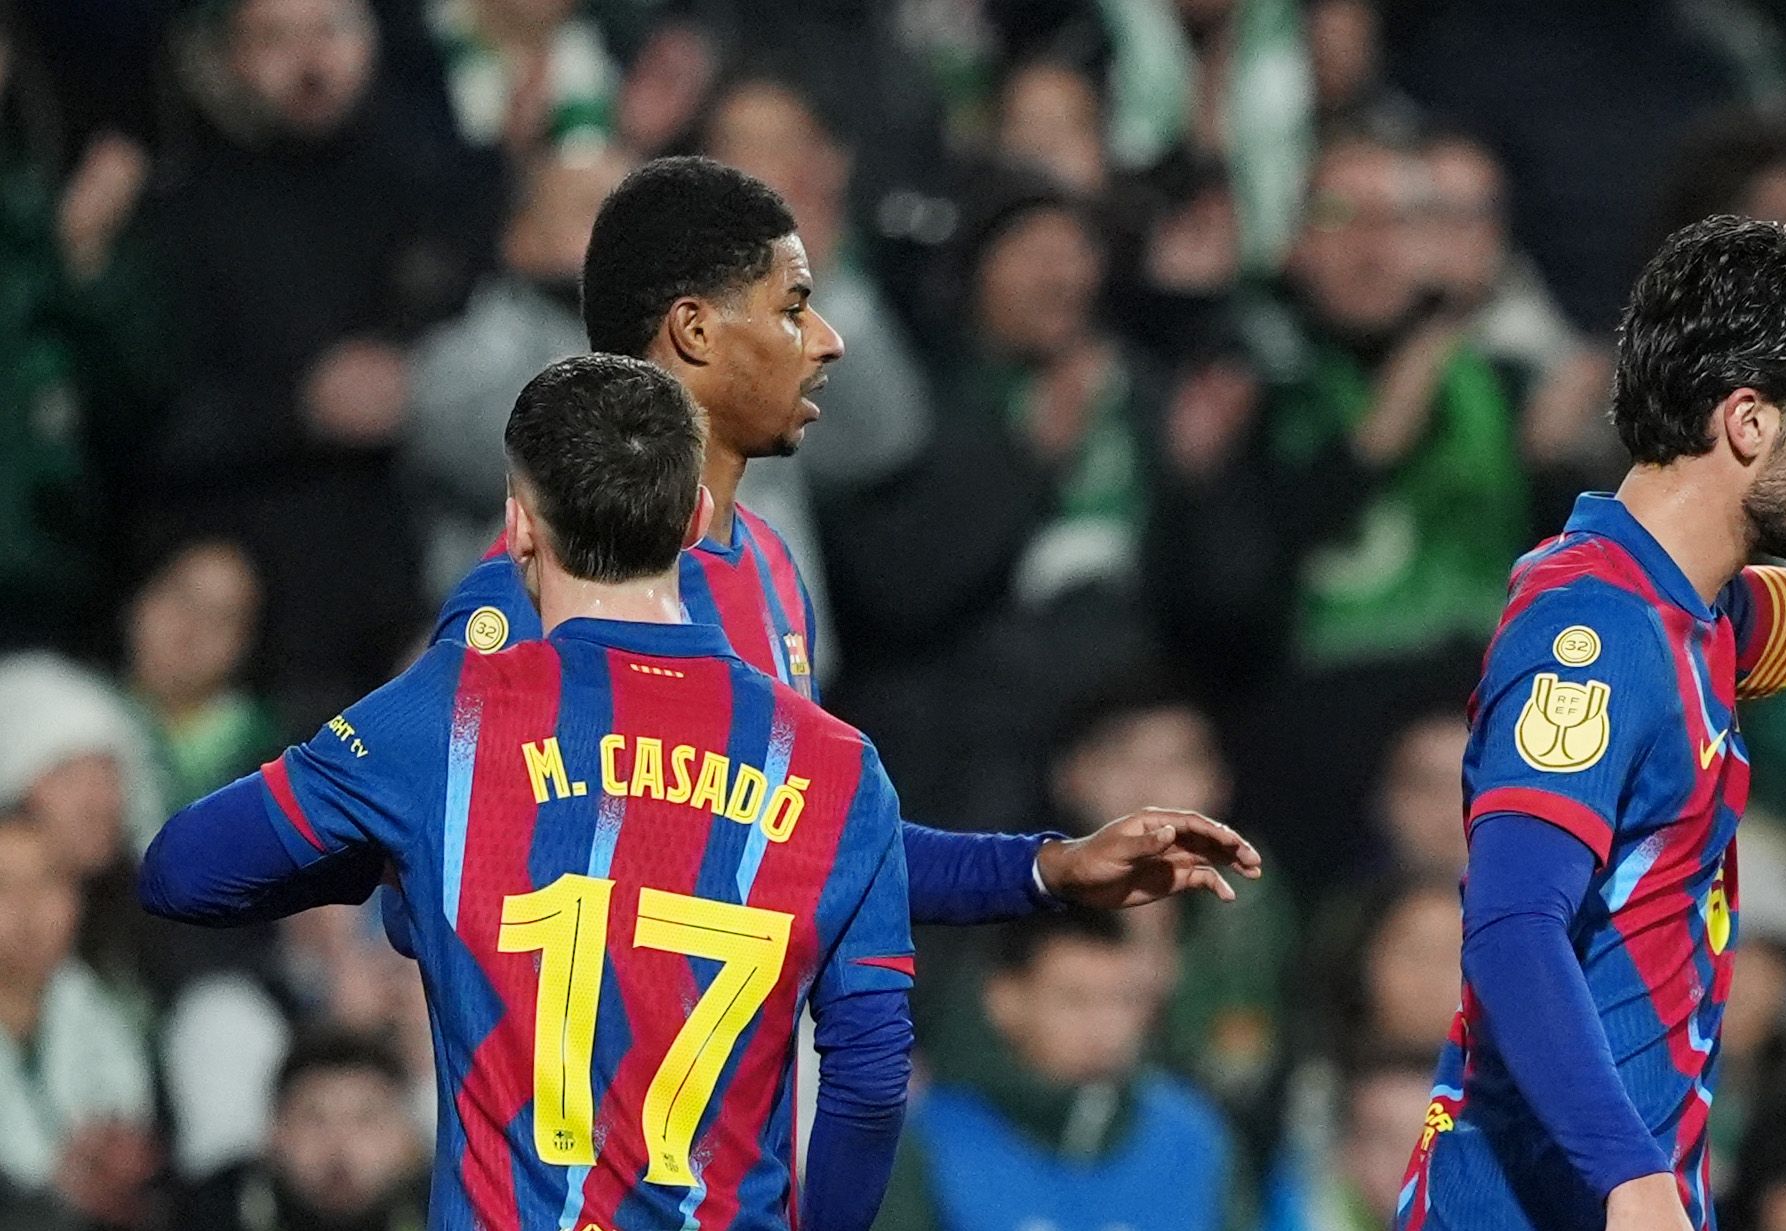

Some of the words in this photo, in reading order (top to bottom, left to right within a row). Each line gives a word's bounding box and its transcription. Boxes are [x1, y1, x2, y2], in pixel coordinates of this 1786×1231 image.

[475, 621, 497, 640] 32
[1564, 640, 1589, 652] 32
[521, 736, 588, 804] M.
[600, 734, 811, 843] CASADÓ
[497, 872, 796, 1188] 17
